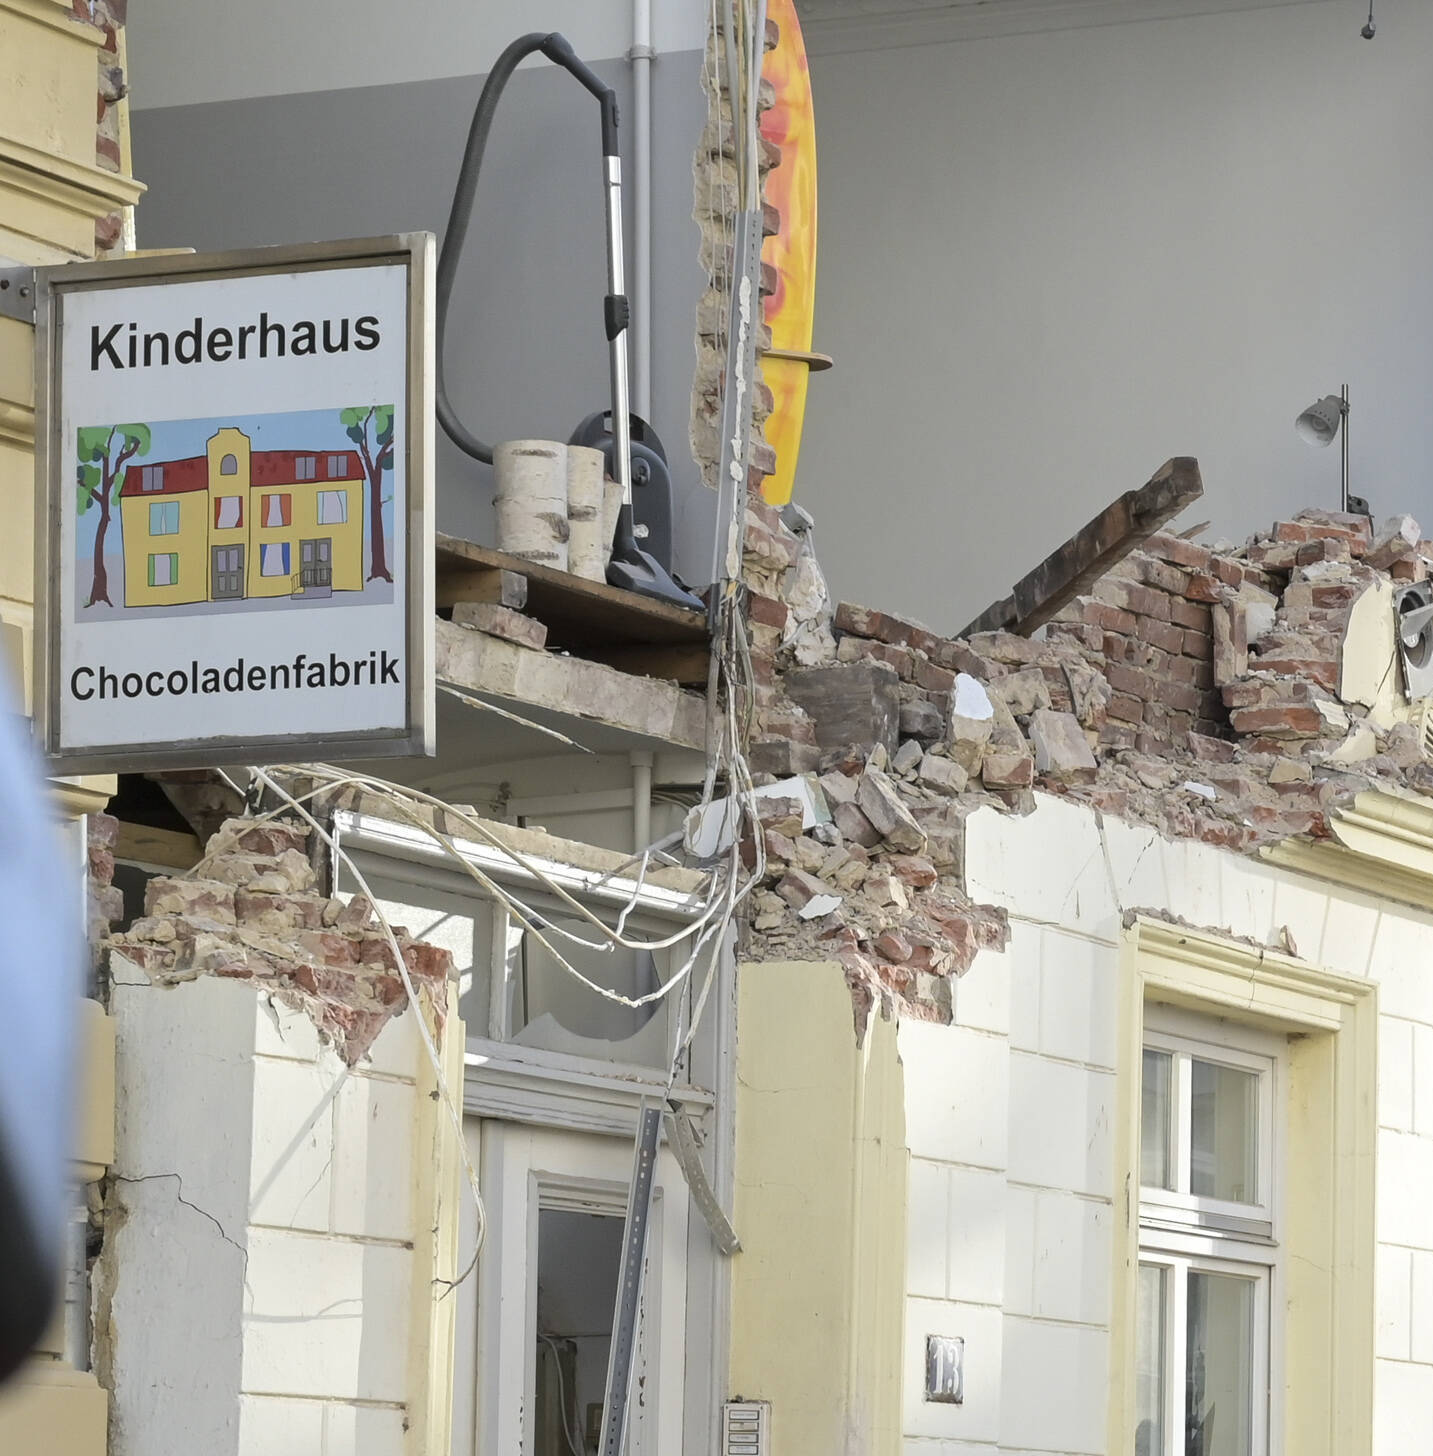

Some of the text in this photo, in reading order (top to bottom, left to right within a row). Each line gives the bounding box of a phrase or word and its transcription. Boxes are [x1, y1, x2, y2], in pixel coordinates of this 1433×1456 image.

[90, 312, 381, 371] Kinderhaus
[71, 650, 401, 701] Chocoladenfabrik
[932, 1342, 960, 1394] 13
